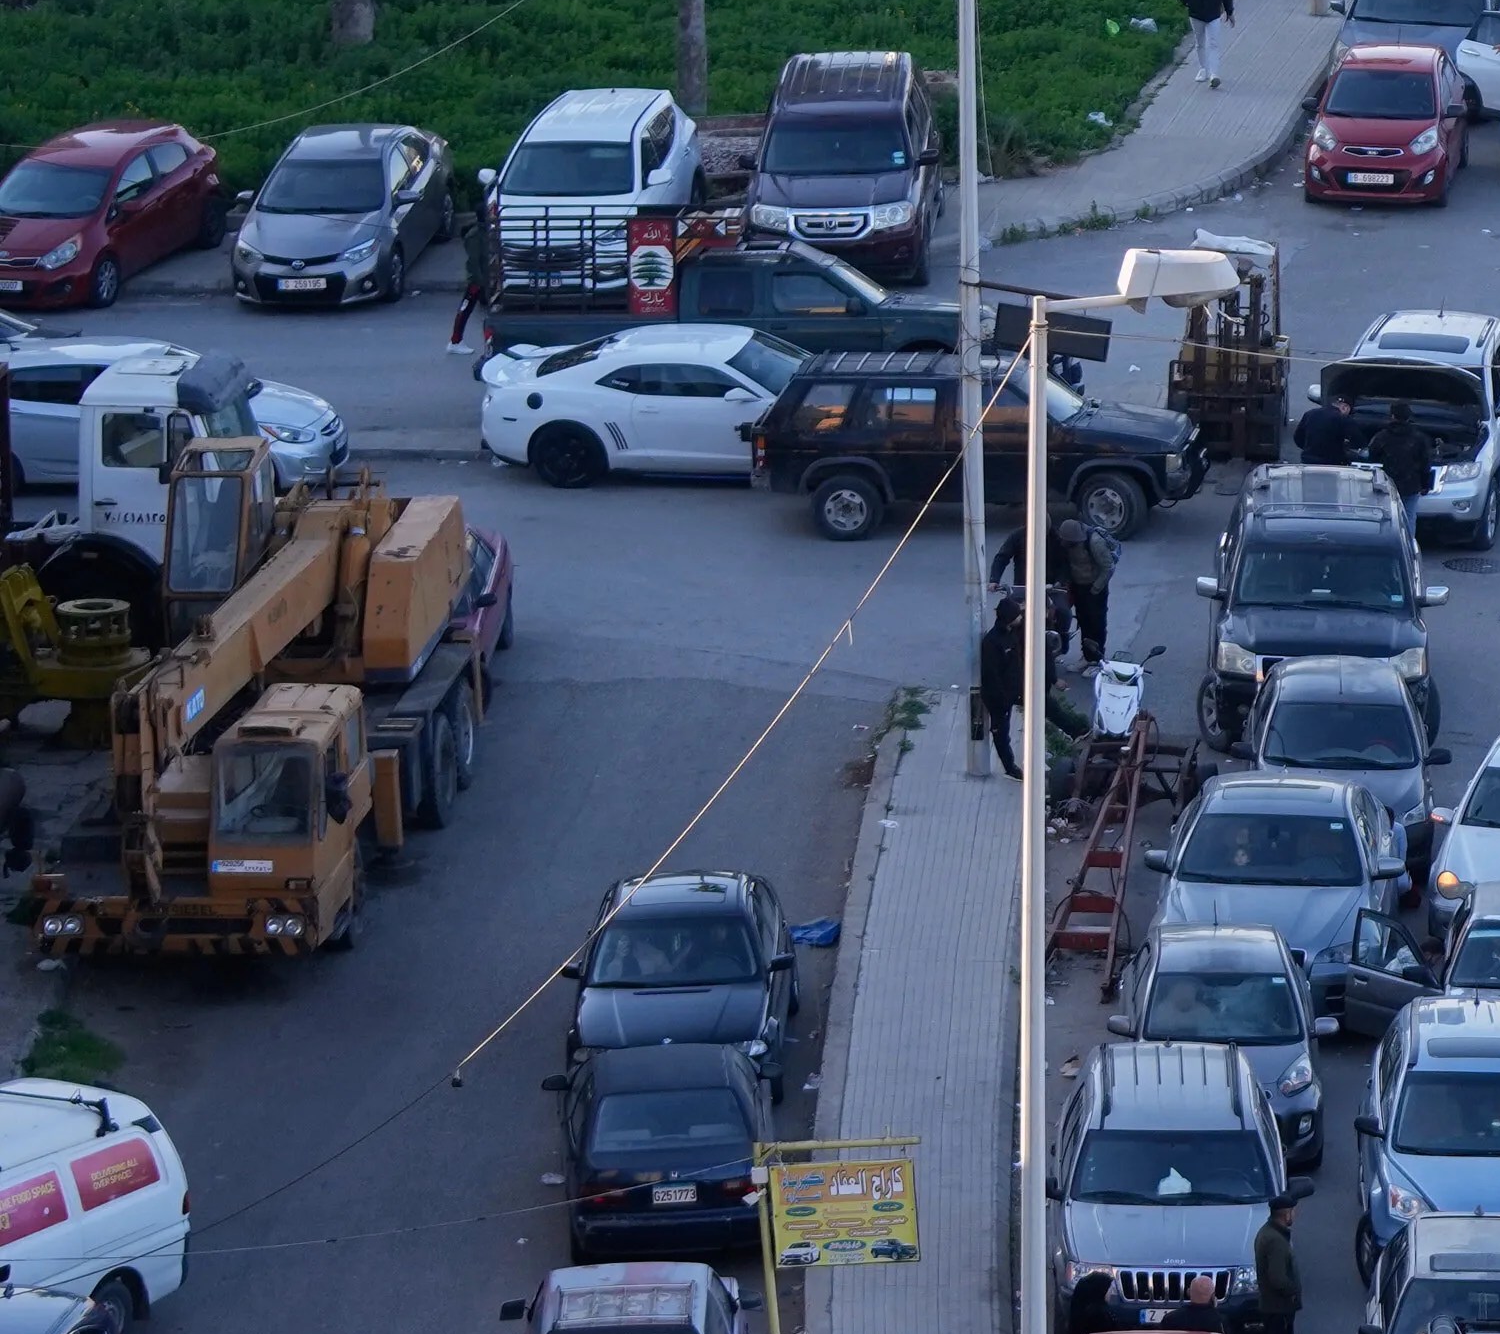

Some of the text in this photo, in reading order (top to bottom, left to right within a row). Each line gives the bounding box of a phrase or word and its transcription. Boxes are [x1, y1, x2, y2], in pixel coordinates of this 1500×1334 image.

[642, 222, 661, 239] الله
[640, 291, 665, 306] يبارك
[185, 686, 205, 722] KATO
[90, 1162, 128, 1181] DELIVERING
[14, 1179, 56, 1203] FOOD SPACE
[92, 1178, 109, 1190] OVER
[654, 1187, 696, 1202] G251773
[1163, 1257, 1186, 1265] Jeep
